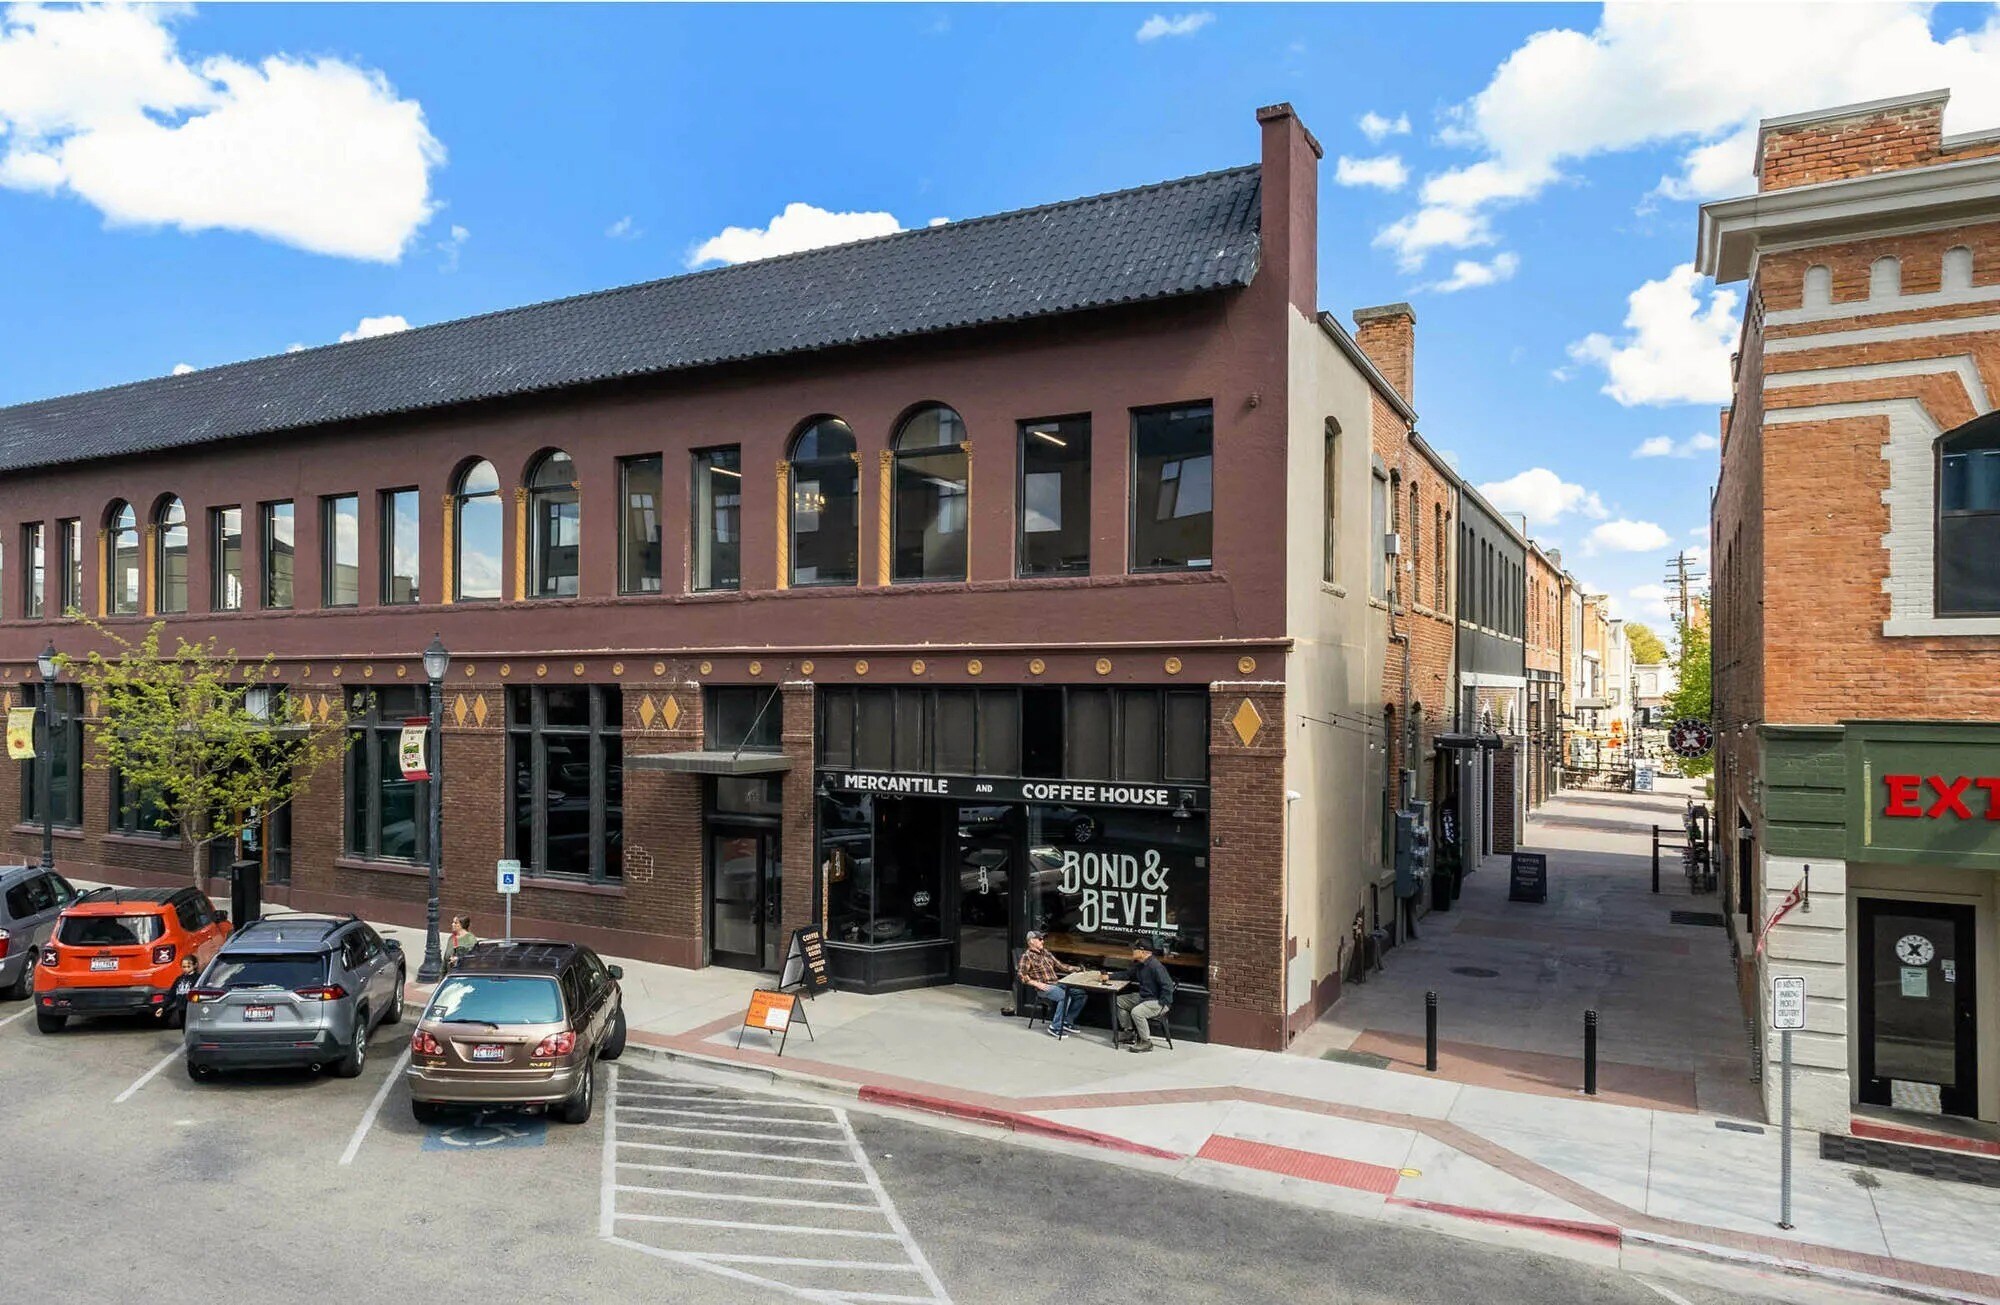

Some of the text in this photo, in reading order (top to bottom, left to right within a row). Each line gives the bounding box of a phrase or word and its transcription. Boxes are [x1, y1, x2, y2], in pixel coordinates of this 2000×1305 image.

[844, 774, 1169, 805] MERCANTILE AND COFFEE HOUSE
[1076, 888, 1179, 933] BEVEL
[1101, 925, 1133, 933] MERCANTILE
